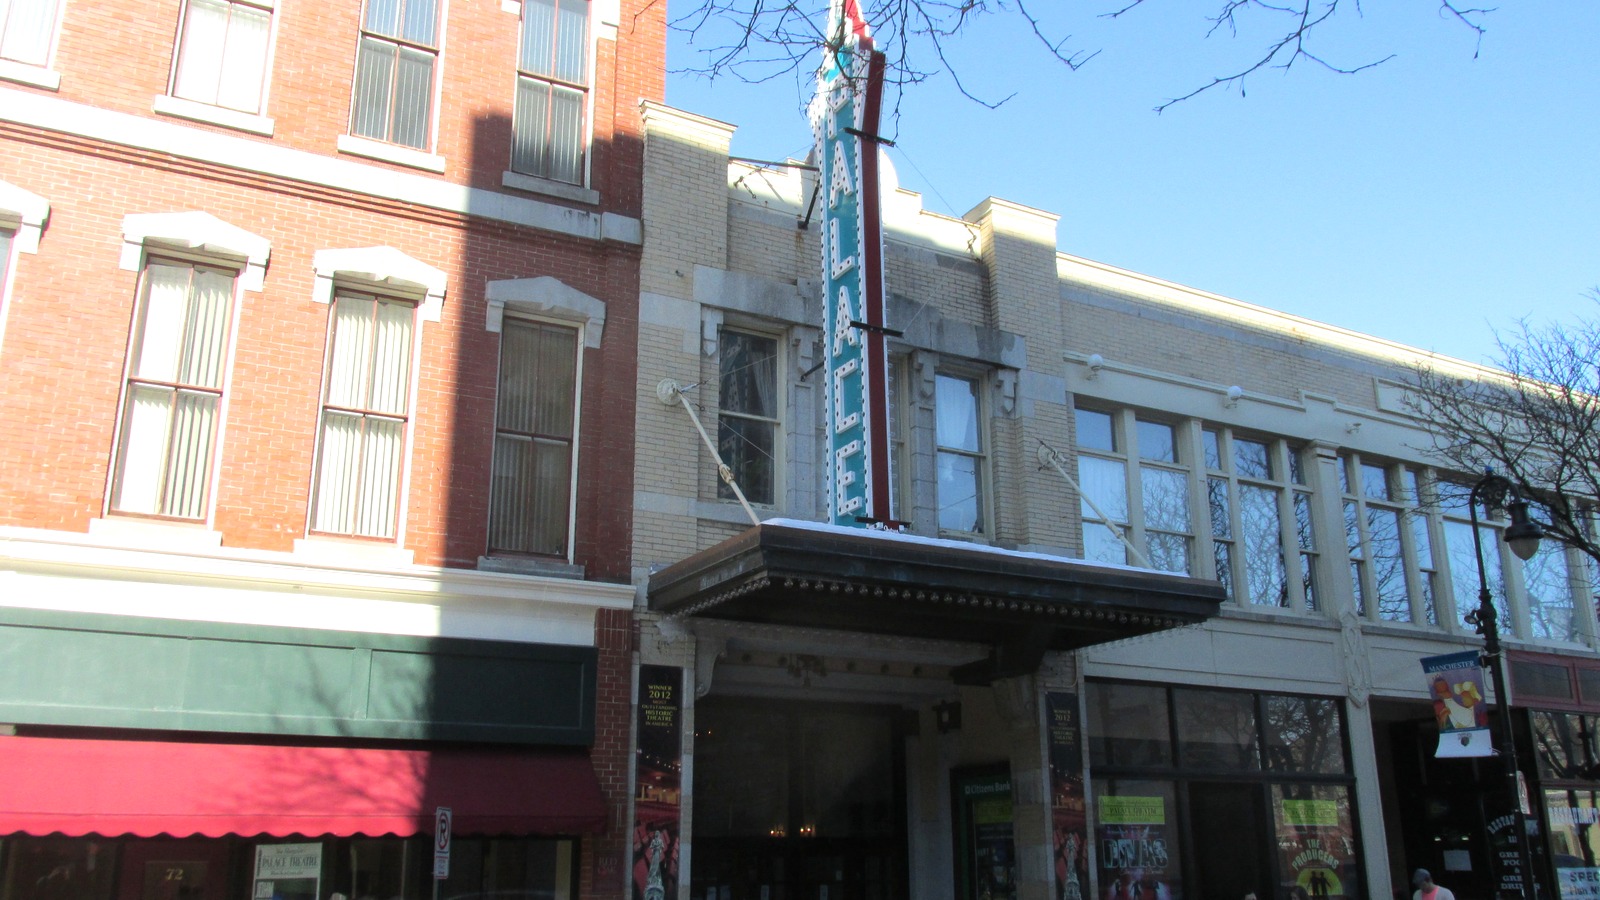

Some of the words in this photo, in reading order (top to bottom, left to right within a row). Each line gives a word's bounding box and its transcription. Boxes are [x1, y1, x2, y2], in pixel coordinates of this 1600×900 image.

[826, 74, 864, 518] PALACE
[1428, 660, 1476, 672] MANCHESTER
[649, 690, 671, 699] 2012
[971, 785, 994, 794] Citizens
[995, 781, 1011, 792] Bank
[1306, 839, 1320, 849] THE
[1102, 838, 1168, 869] DIVAS
[1291, 848, 1340, 871] PRODUCERS
[262, 857, 285, 867] PALACE
[289, 855, 318, 867] THEATRE
[165, 868, 184, 881] 72
